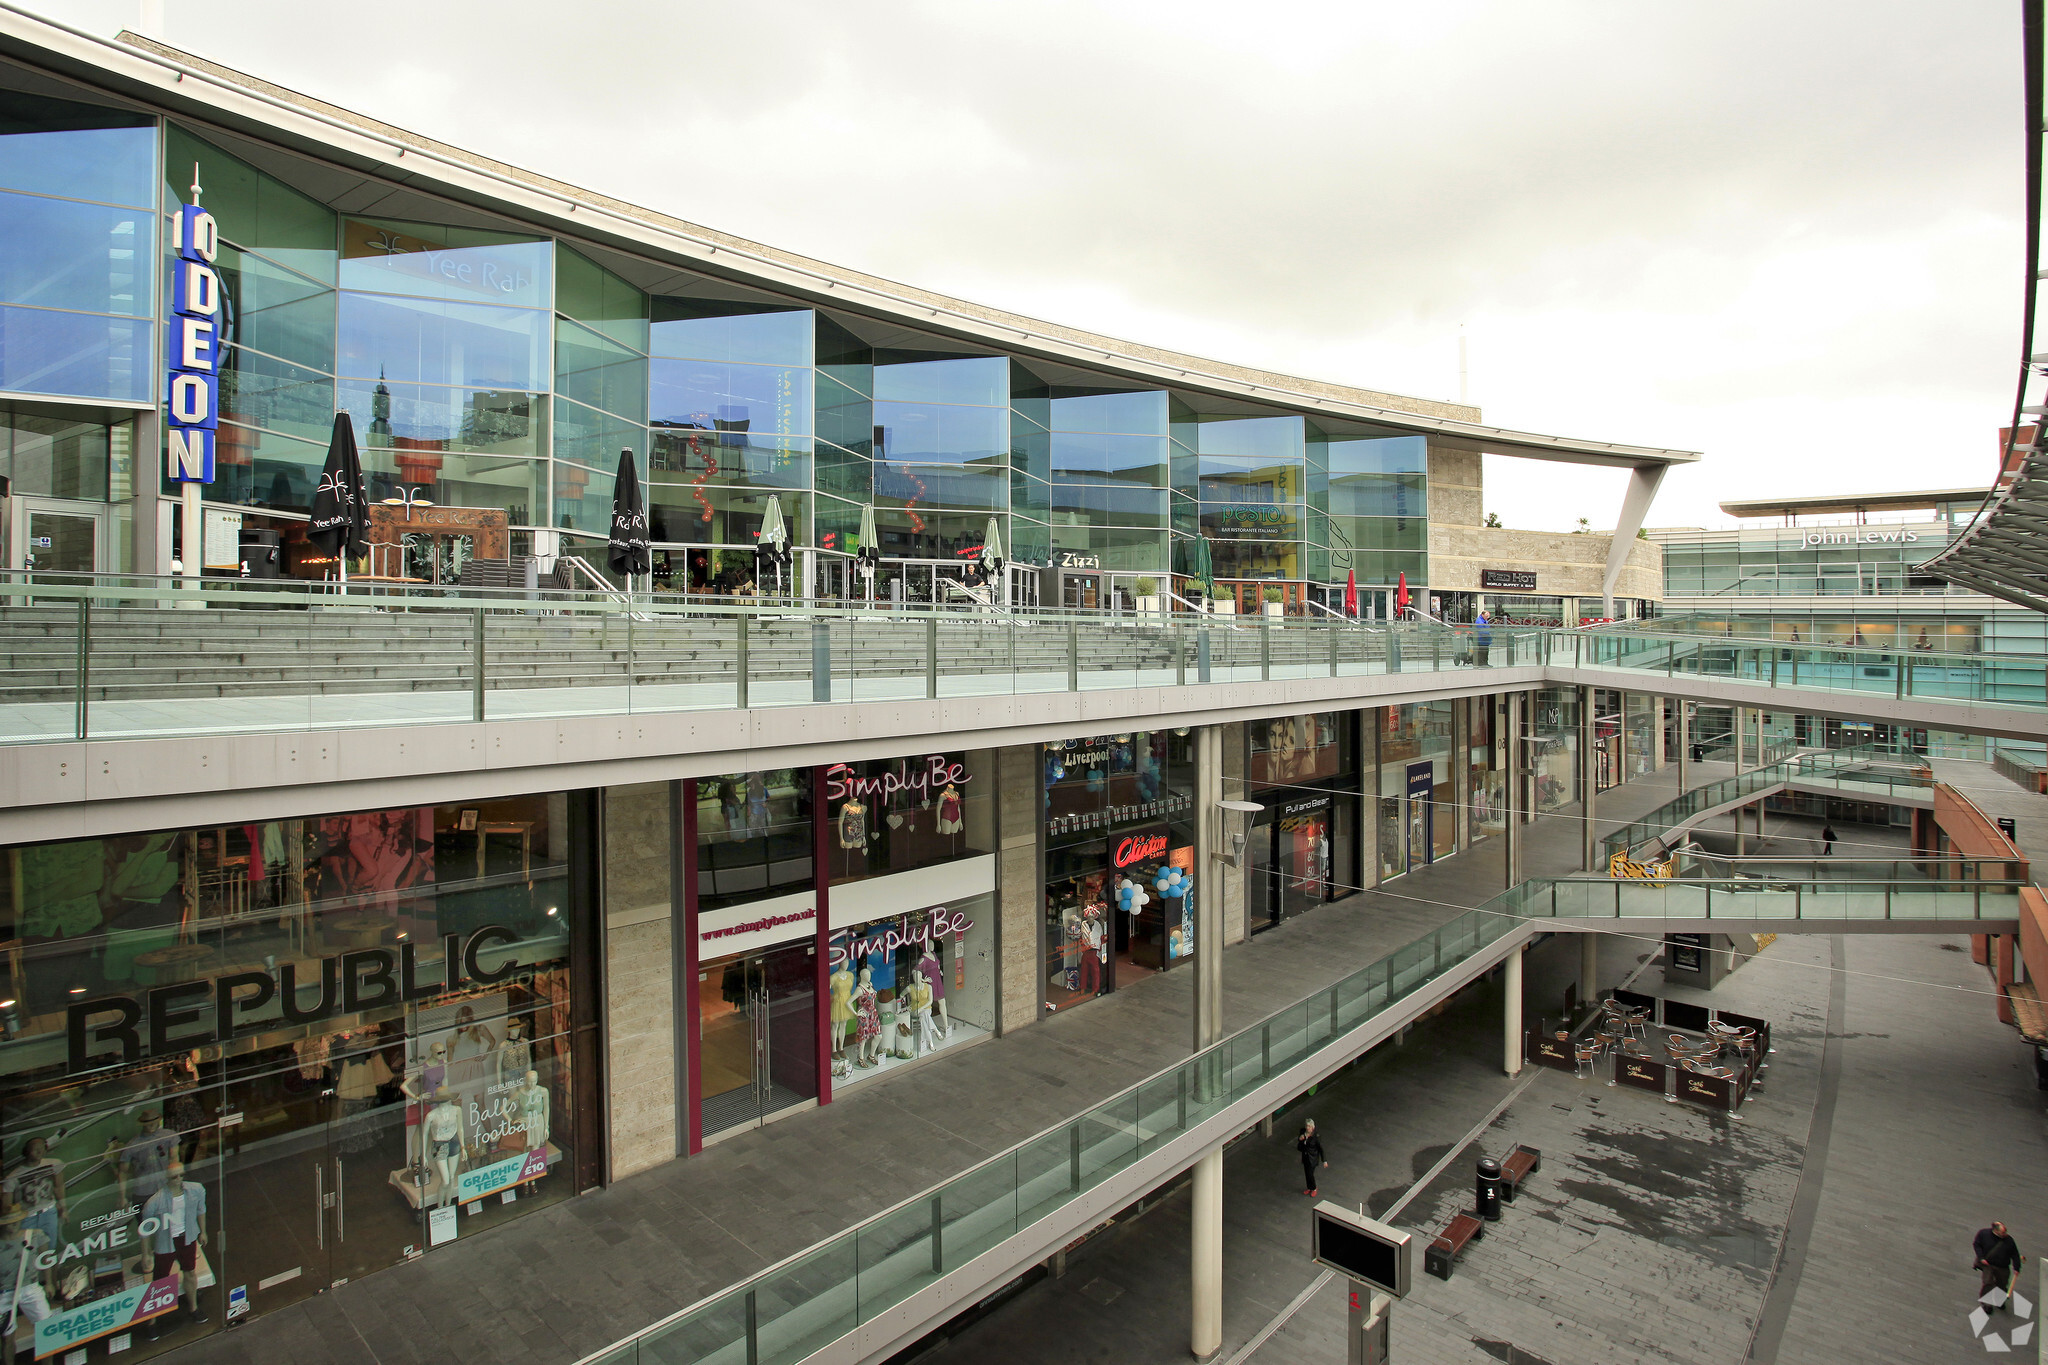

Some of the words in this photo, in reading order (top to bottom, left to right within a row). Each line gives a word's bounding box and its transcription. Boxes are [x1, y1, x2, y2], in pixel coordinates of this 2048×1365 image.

[422, 245, 473, 284] Yee
[482, 262, 531, 293] Rah
[169, 212, 218, 479] ODEON
[416, 509, 446, 524] Yee
[1800, 527, 1849, 549] John
[1856, 525, 1919, 544] Lewis
[1062, 552, 1099, 570] Zizzi
[1064, 749, 1110, 769] Liverpool
[826, 755, 973, 807] SimplyBe
[1413, 772, 1431, 783] LAKELAND
[1285, 805, 1299, 814] Pull
[1299, 802, 1311, 811] and
[1311, 797, 1330, 808] Bear
[1114, 834, 1168, 868] Clinton
[701, 908, 817, 941] www.simplybe.co.uk
[828, 906, 974, 965] SimplyBe
[66, 924, 519, 1077] REPUBLIC
[487, 1077, 525, 1094] REPUBLIC
[469, 1098, 517, 1127] Balls
[473, 1110, 541, 1150] football
[463, 1162, 520, 1188] GRAPHIC
[524, 1162, 545, 1176] £10
[475, 1174, 508, 1193] TEES
[81, 1204, 141, 1229] REPUBLIC
[34, 1225, 129, 1271] GAME
[43, 1296, 135, 1338] GRAPHIC
[142, 1292, 175, 1313] £10
[63, 1314, 116, 1342] TEES
